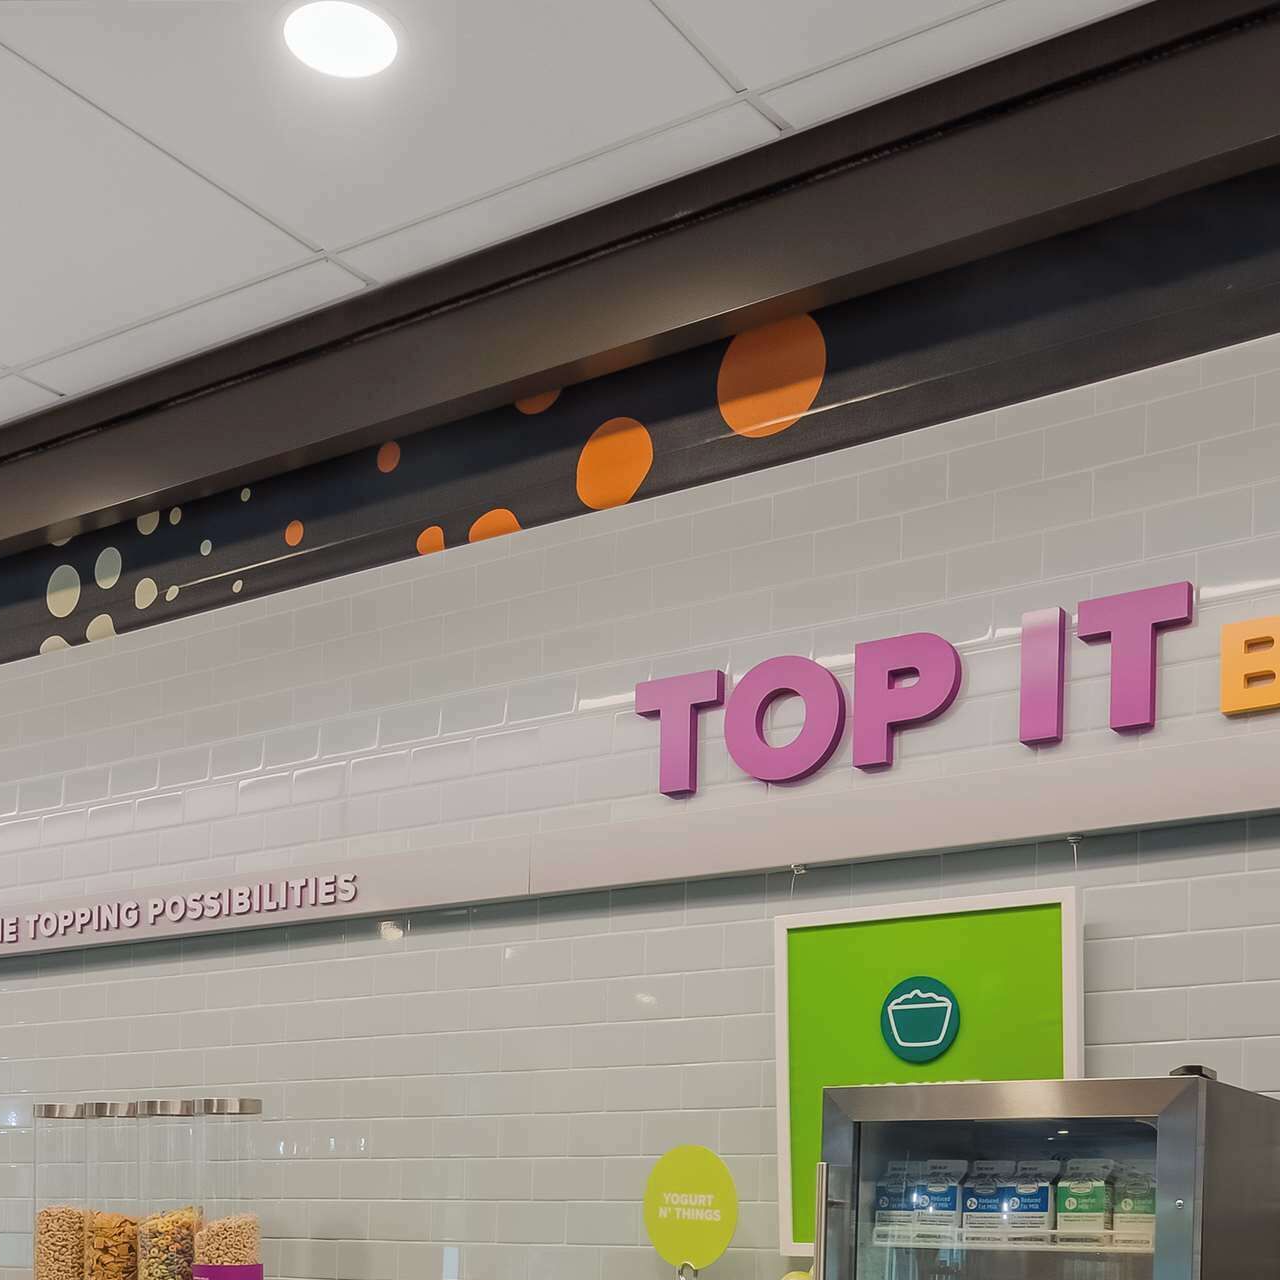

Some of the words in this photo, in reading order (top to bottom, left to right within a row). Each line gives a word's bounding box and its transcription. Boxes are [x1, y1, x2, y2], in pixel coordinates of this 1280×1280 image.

[635, 632, 962, 799] TOP
[1019, 581, 1193, 748] IT
[26, 900, 140, 940] TOPPING
[148, 872, 358, 925] POSSIBILITIES
[663, 1192, 714, 1206] YOGURT
[675, 1208, 721, 1221] THINGS
